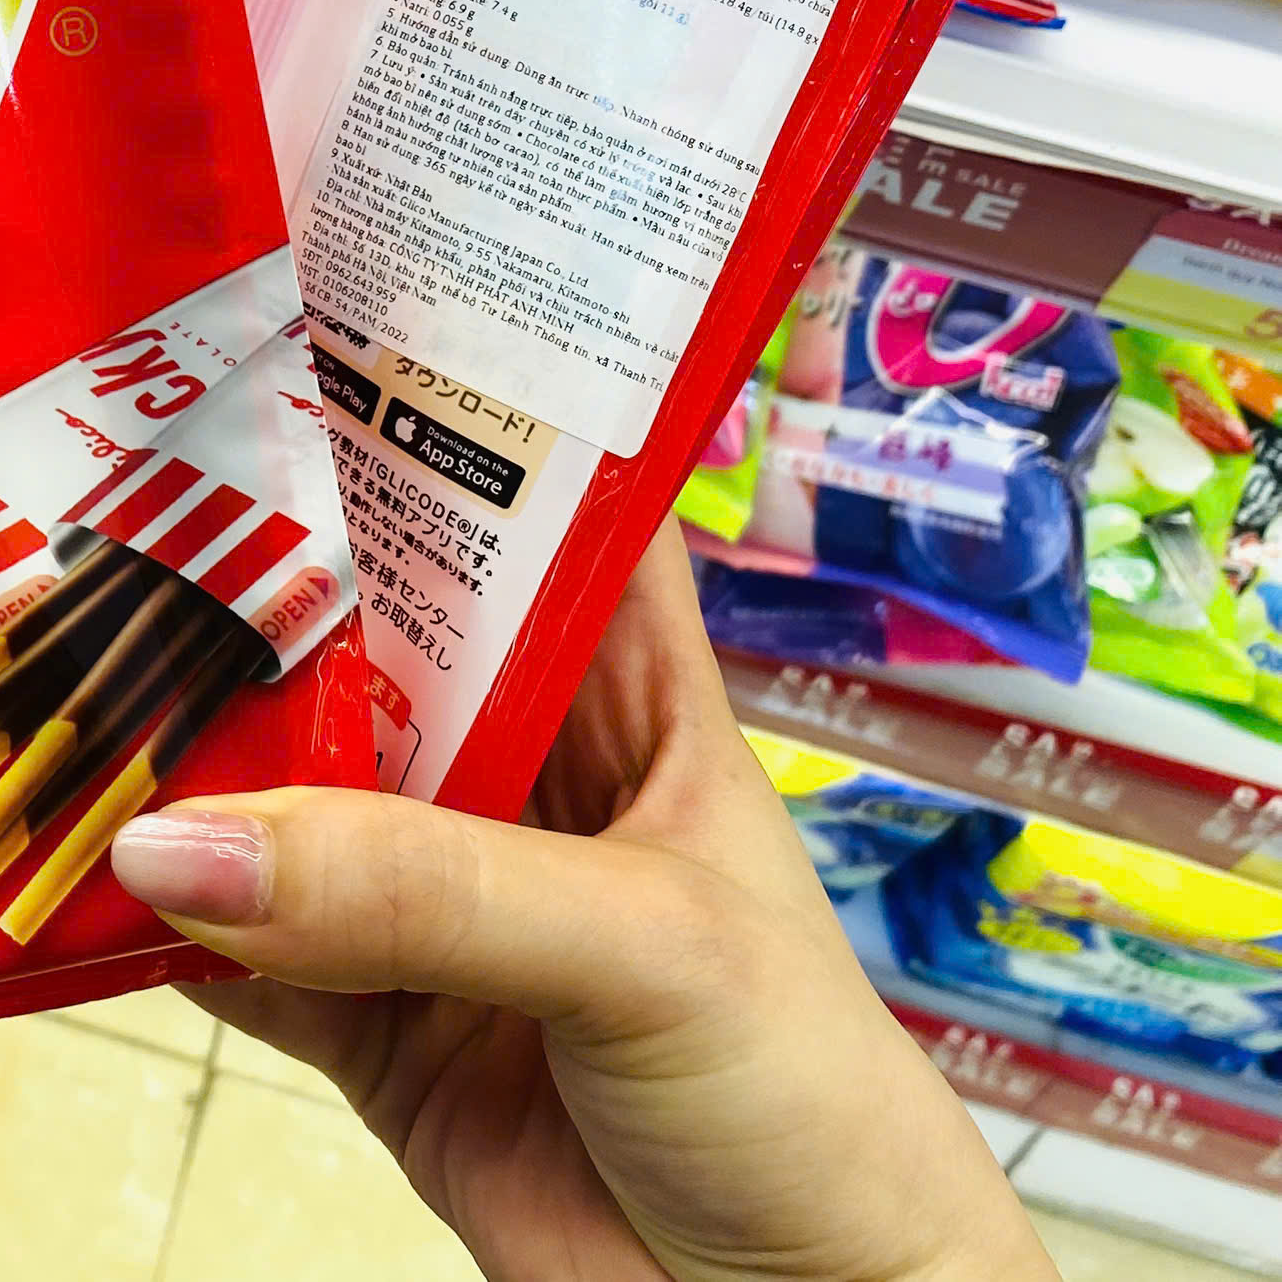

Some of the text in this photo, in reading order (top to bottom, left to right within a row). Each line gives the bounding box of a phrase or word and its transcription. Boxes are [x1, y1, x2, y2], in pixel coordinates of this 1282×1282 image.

[418, 36, 439, 53] bao
[382, 70, 403, 88] bao
[423, 156, 448, 174] 365
[856, 159, 1023, 232] ALE
[399, 195, 544, 269] Glico Manufacturing Japan
[320, 274, 391, 317] 0106208110
[509, 298, 539, 318] ANH
[539, 310, 575, 334] MINH
[341, 384, 368, 414] Play
[417, 438, 503, 496] App Store
[426, 425, 509, 478] Download on the
[331, 451, 493, 577] できる無料アプリです。
[259, 587, 318, 642] OPEN
